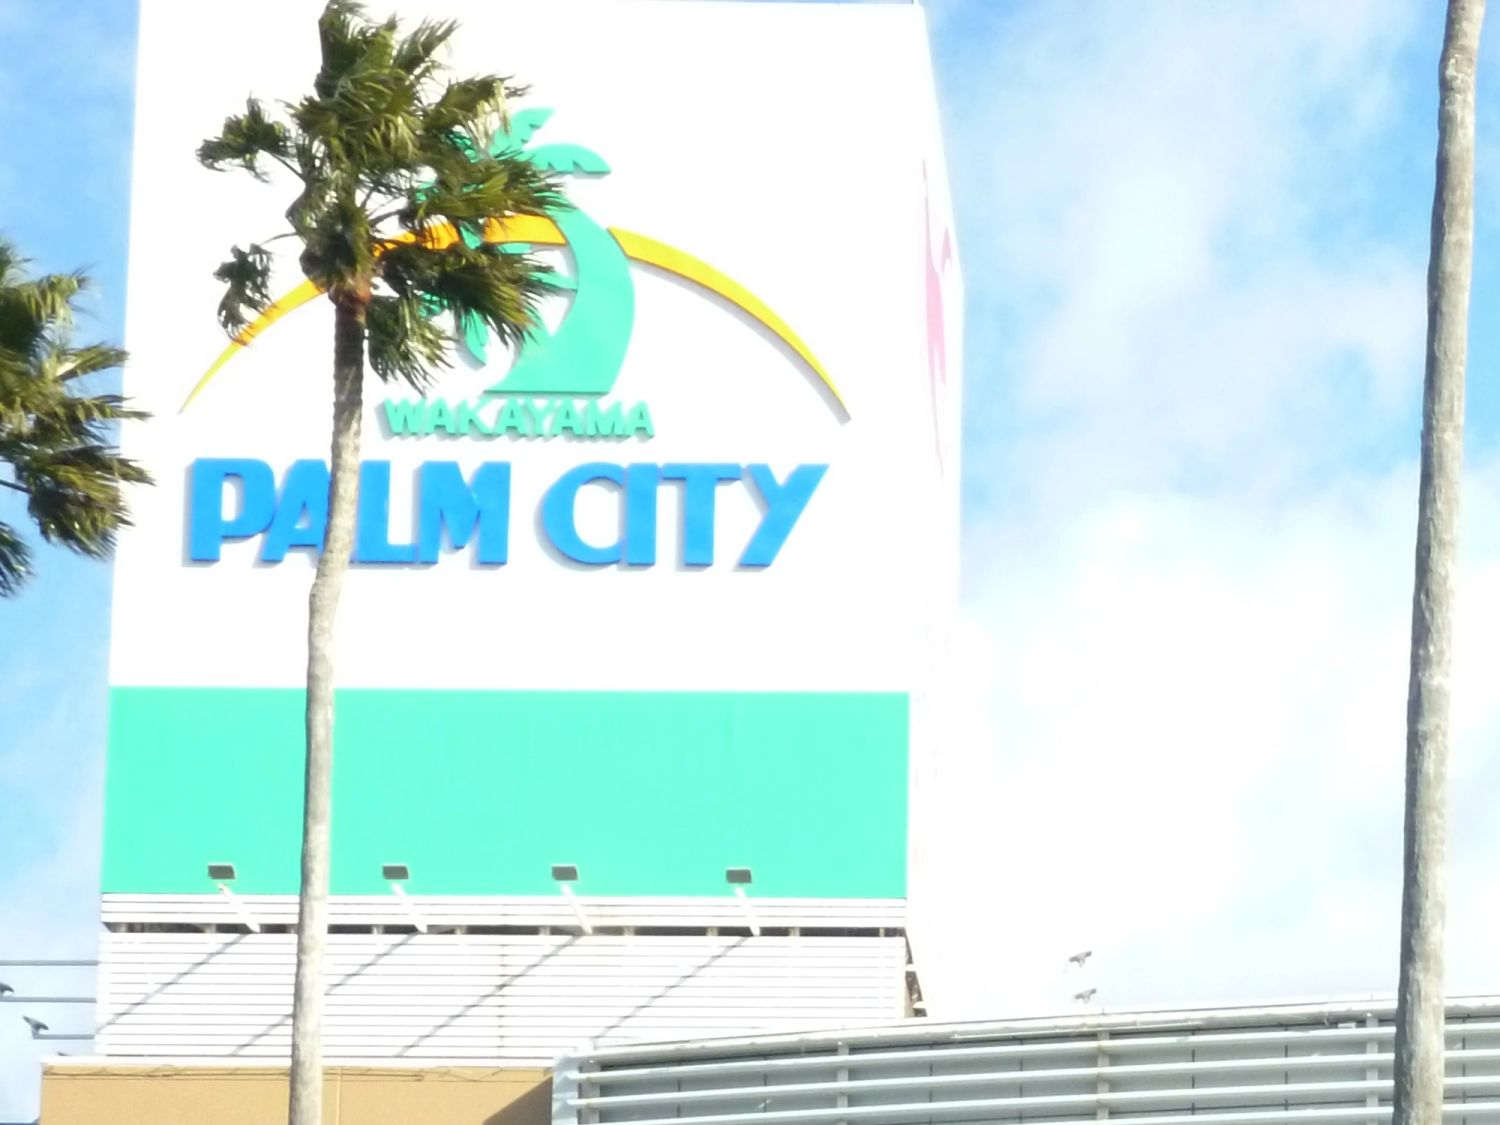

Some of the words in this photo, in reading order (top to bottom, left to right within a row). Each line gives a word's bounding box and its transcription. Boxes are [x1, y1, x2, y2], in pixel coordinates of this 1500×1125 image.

[382, 396, 655, 438] WAKAYAMA
[187, 457, 511, 565] PALM
[538, 462, 830, 567] CITY
